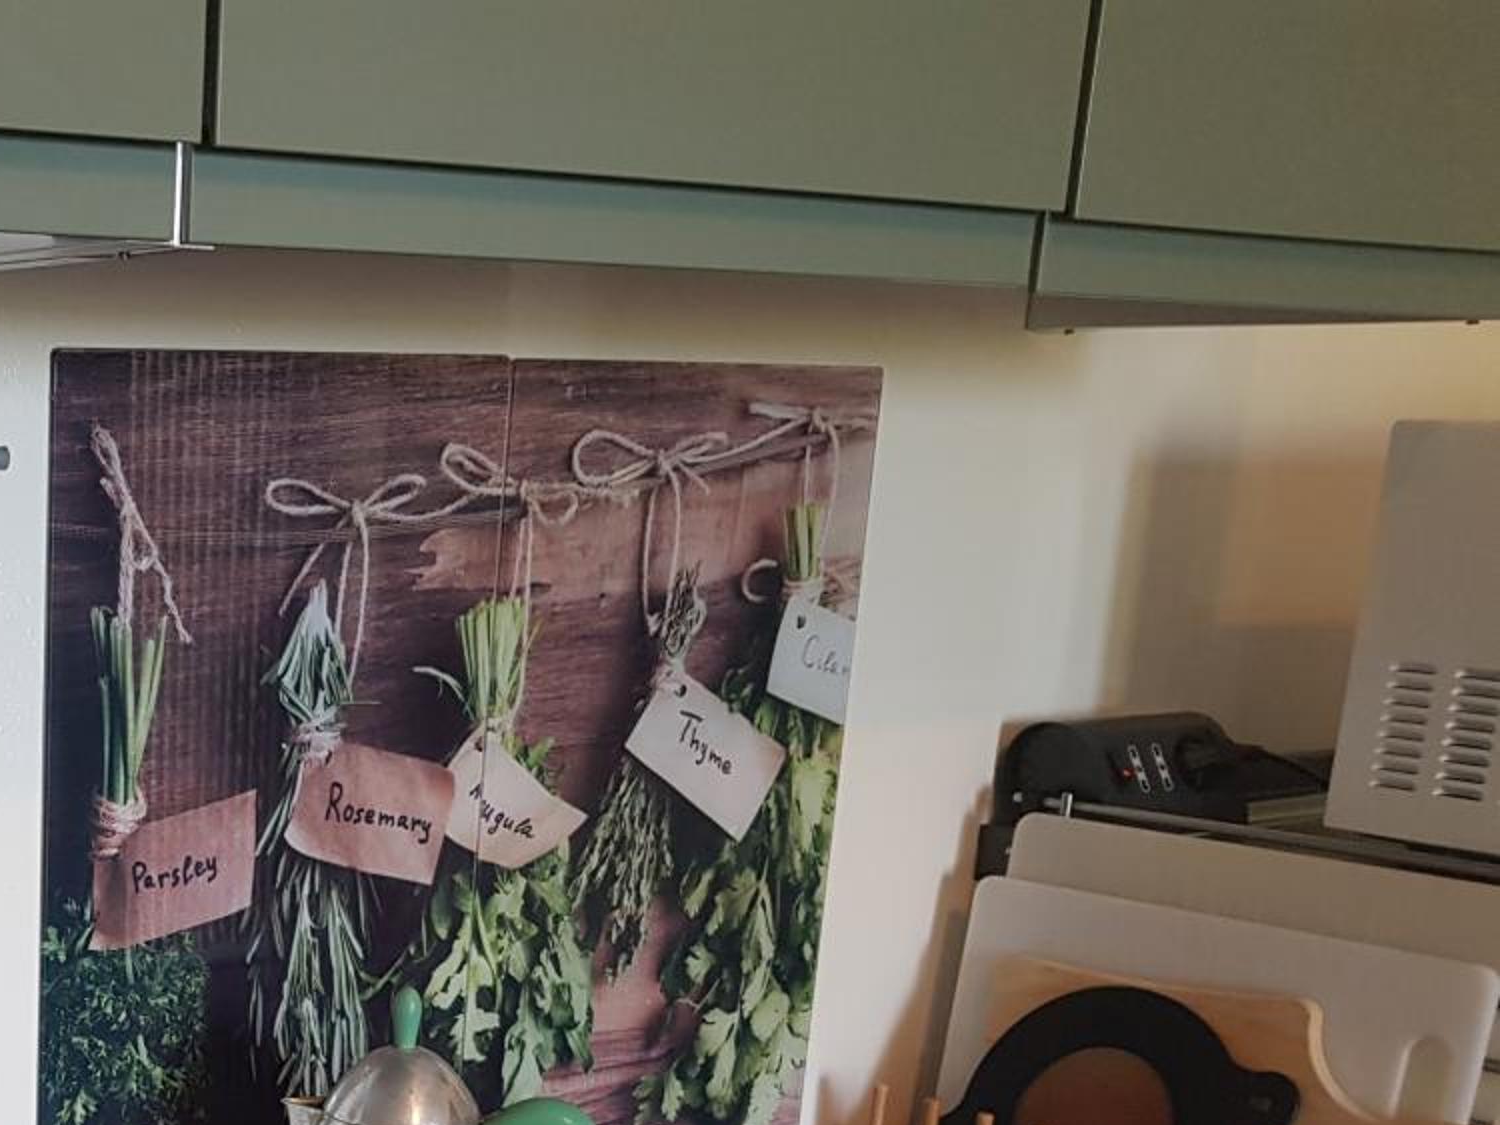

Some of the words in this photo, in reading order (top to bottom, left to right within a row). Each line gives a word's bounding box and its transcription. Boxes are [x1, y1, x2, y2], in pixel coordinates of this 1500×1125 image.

[679, 709, 732, 775] Thyme
[324, 781, 433, 844] Rosemary
[131, 855, 218, 894] Parsley
